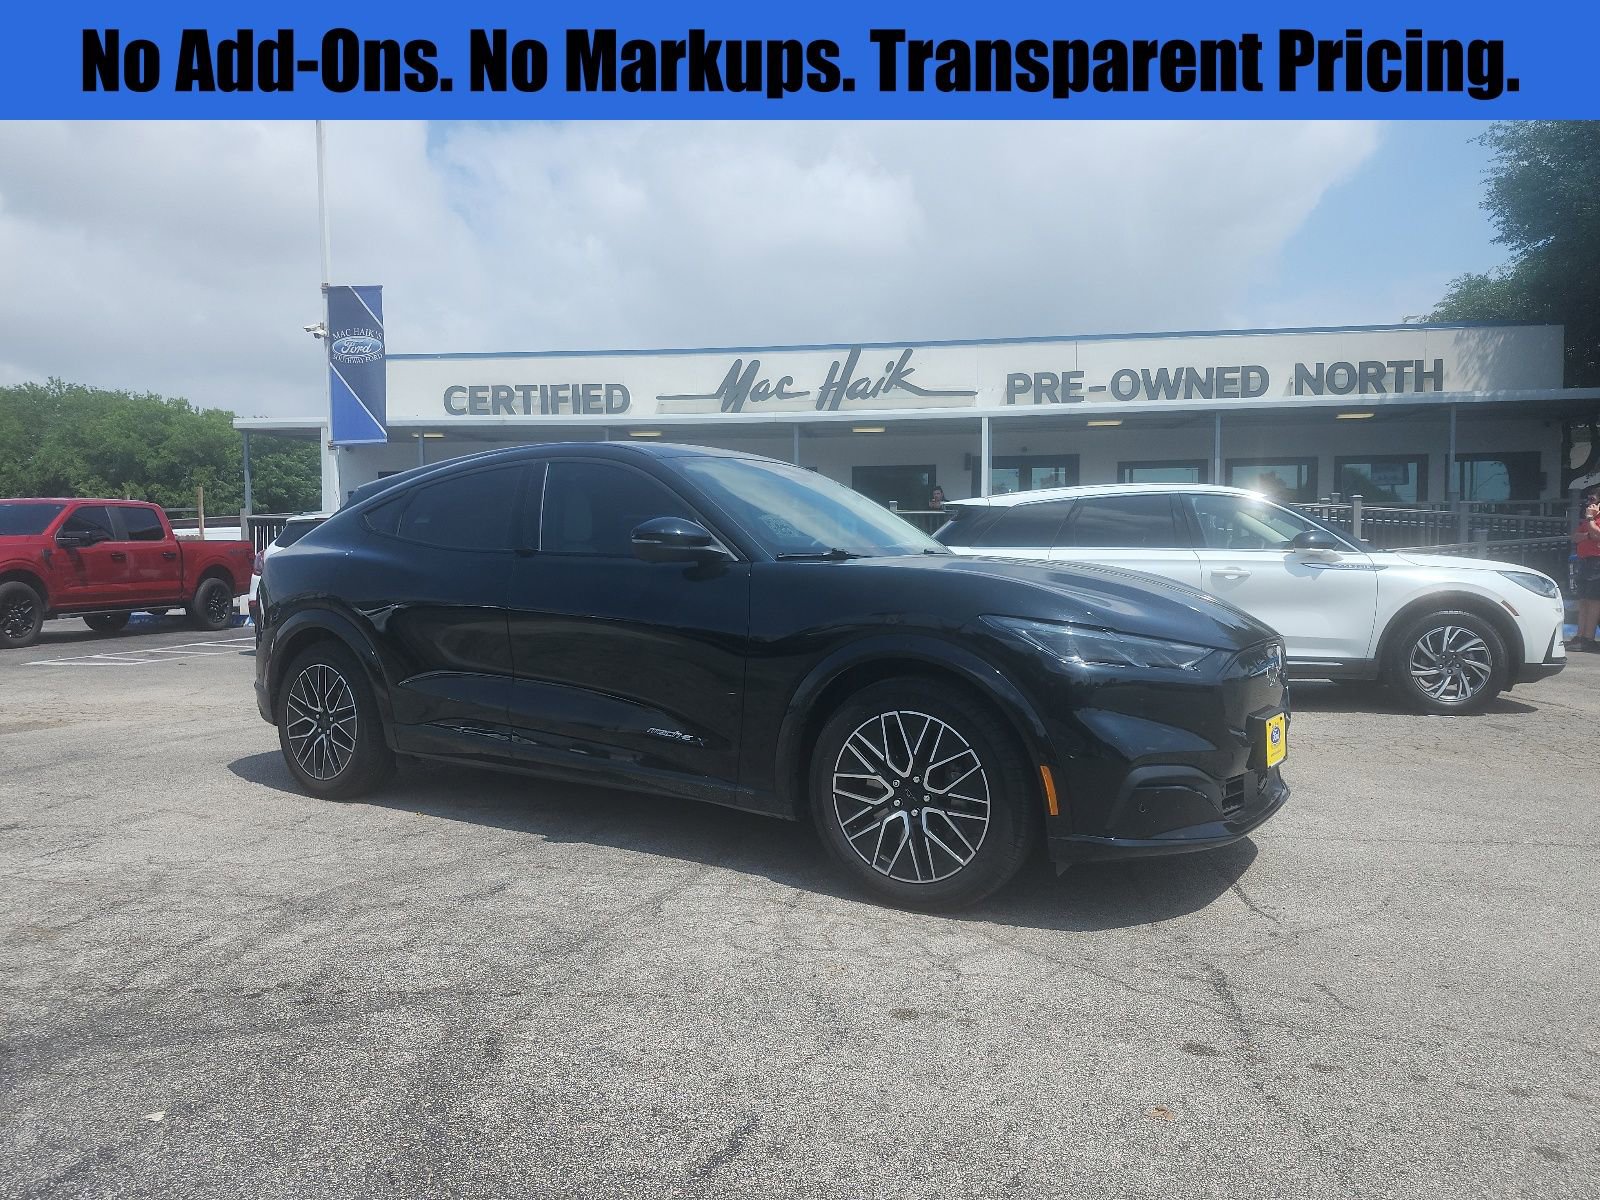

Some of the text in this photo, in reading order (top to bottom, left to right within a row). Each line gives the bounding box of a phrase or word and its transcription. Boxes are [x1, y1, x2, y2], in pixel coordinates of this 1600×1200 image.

[332, 328, 383, 340] MAC HAIK'S
[341, 340, 373, 353] Ford
[656, 345, 978, 414] Mac Haik
[1006, 358, 1445, 405] PRE-OWNED NORTH
[443, 383, 631, 416] CERTIFIED
